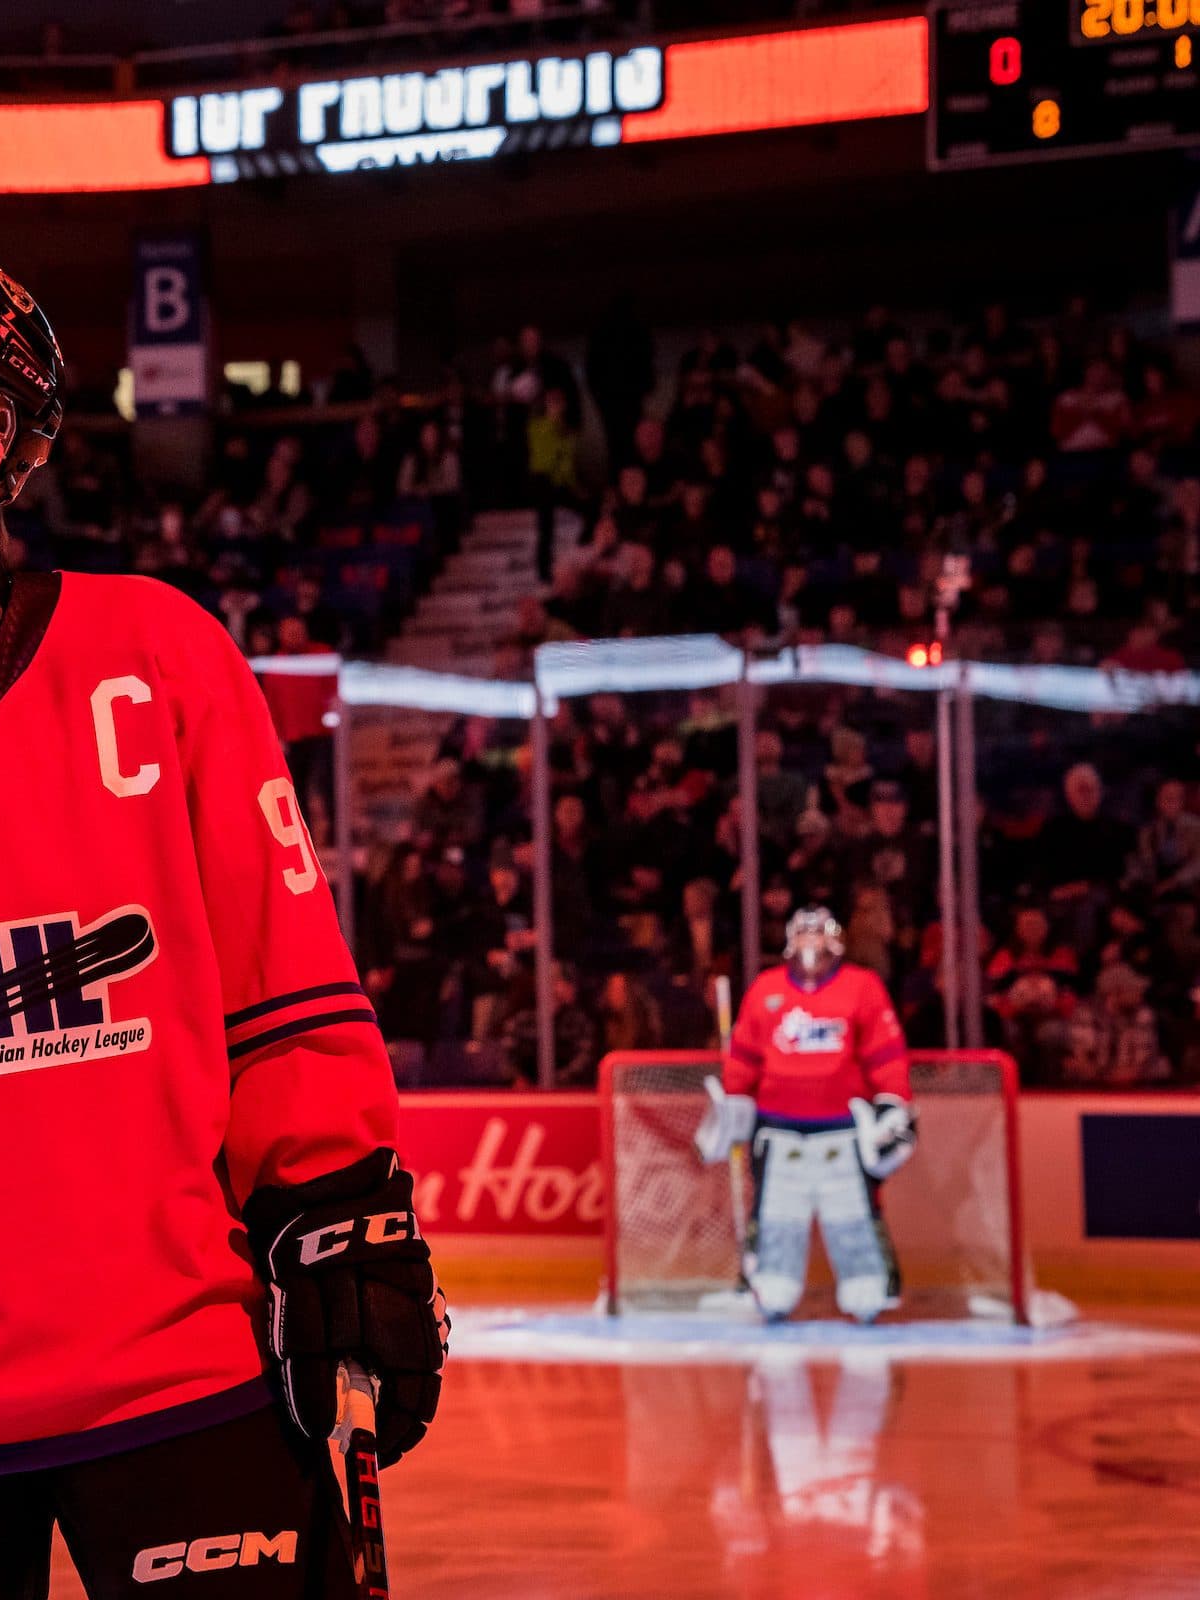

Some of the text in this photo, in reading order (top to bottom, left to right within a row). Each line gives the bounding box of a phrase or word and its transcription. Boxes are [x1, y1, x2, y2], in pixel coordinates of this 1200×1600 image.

[989, 37, 1021, 85] 0
[145, 267, 190, 332] B
[8, 355, 50, 391] CCM
[90, 674, 161, 798] C
[257, 776, 327, 895] 9
[31, 1033, 90, 1058] Hockey
[94, 1026, 145, 1050] League
[132, 1530, 298, 1583] CCM
